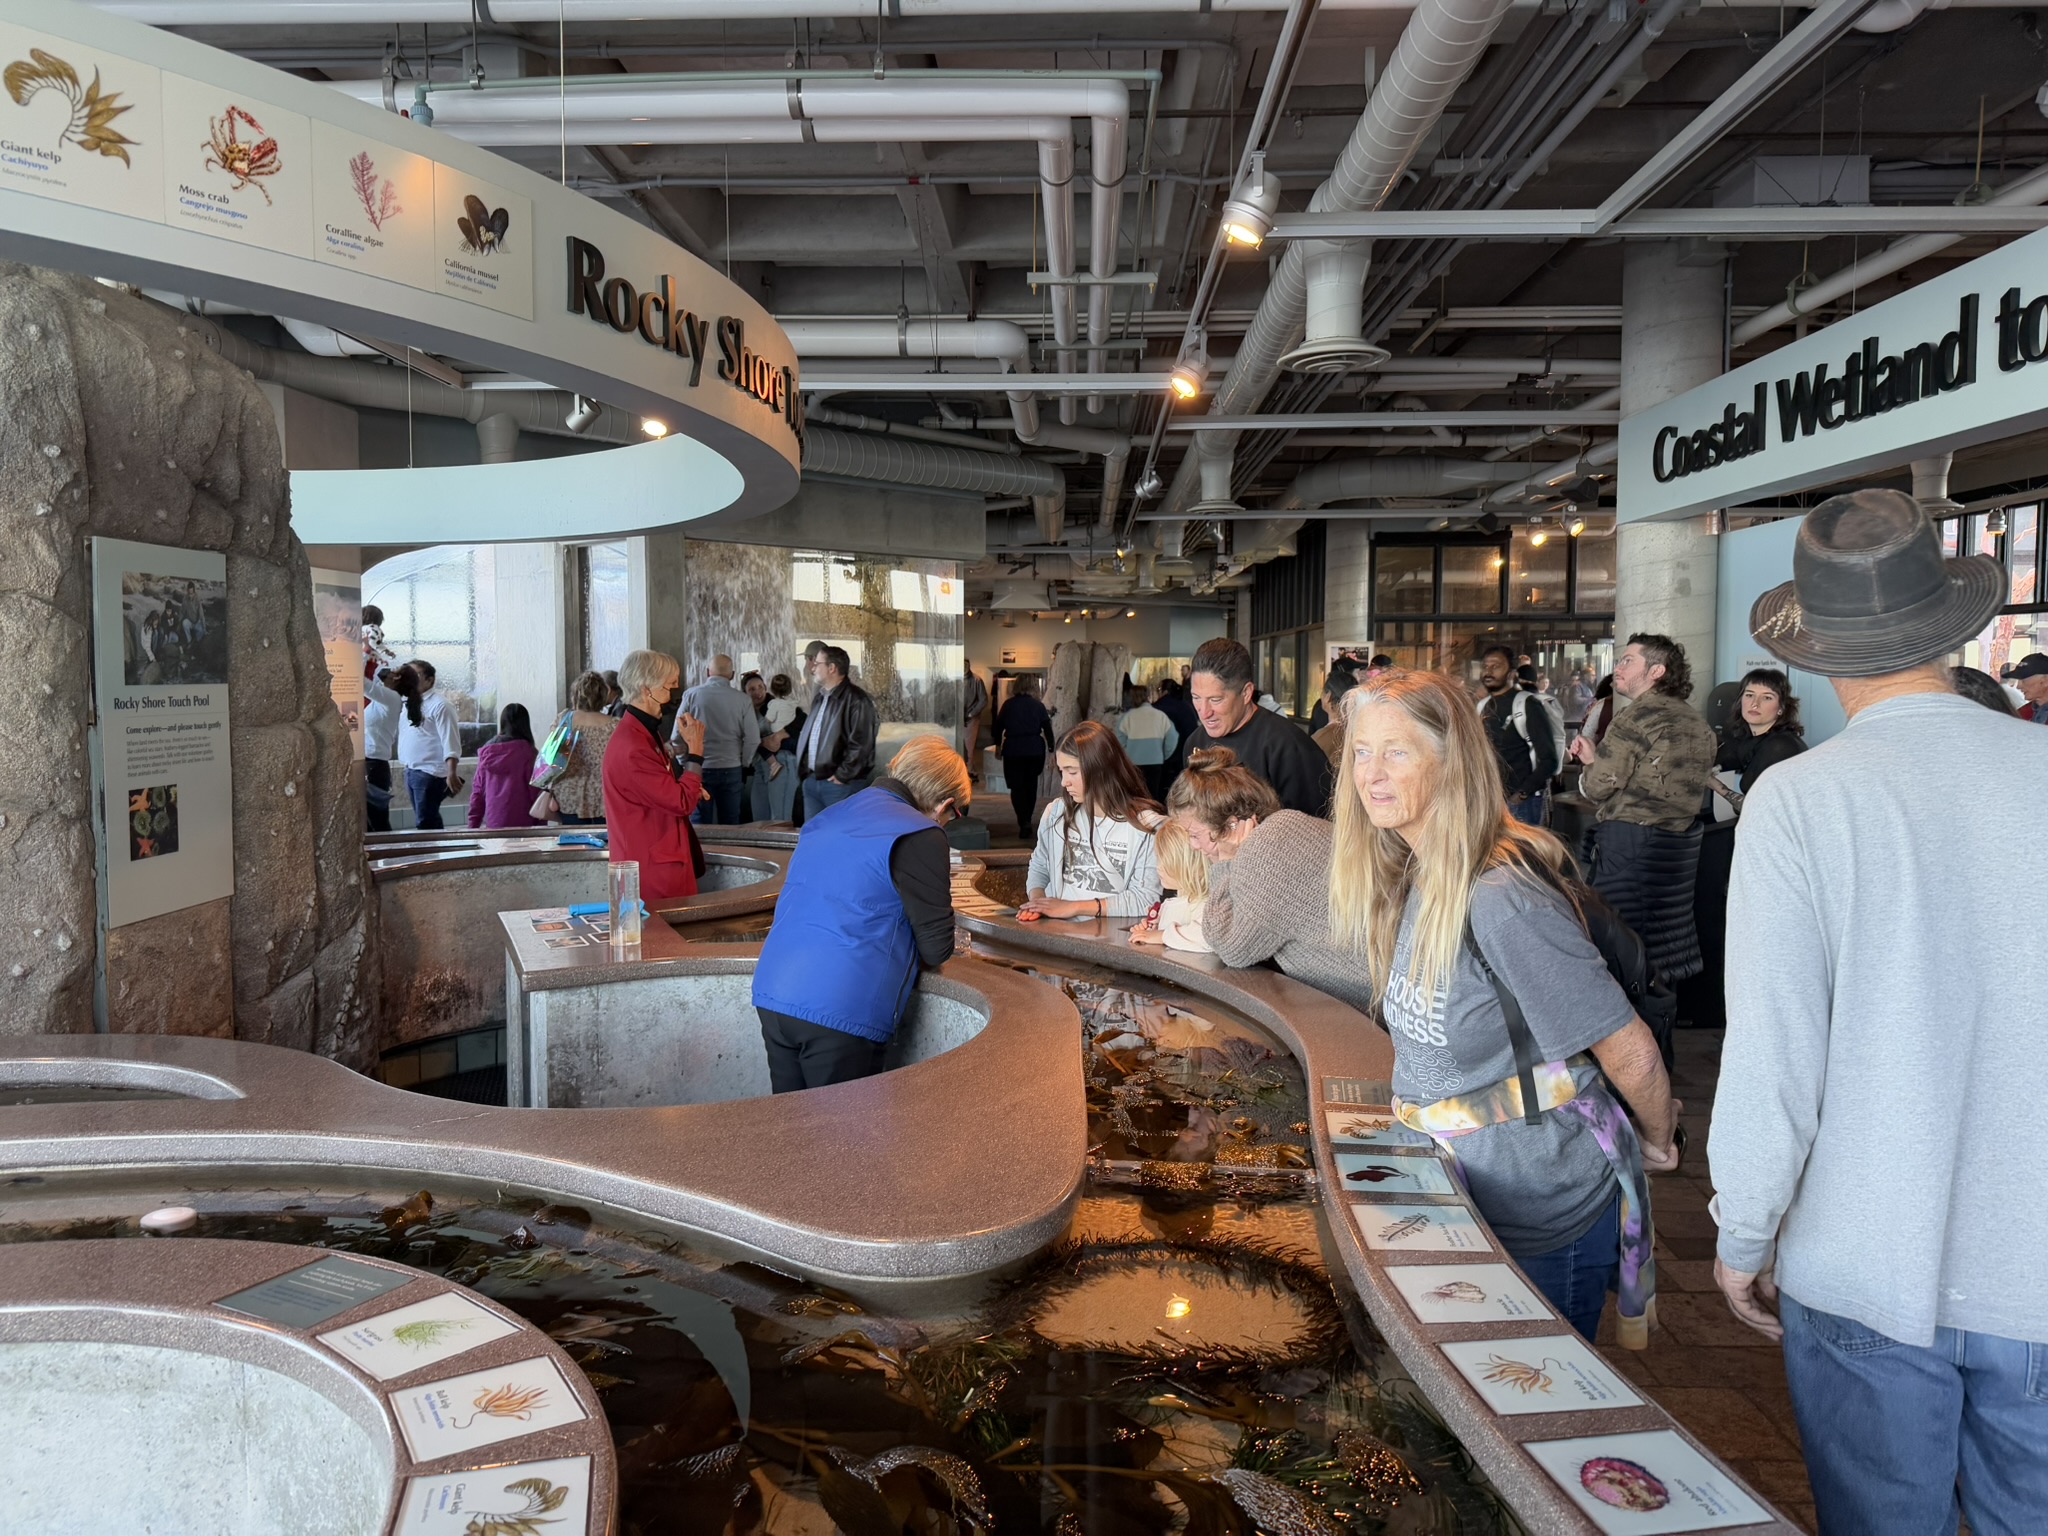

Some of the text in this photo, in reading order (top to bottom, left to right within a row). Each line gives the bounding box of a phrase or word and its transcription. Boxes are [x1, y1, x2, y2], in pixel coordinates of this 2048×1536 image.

[0, 140, 62, 164] Giant kelp
[179, 184, 230, 204] Moss crab
[180, 196, 248, 220] Cangrejo musgoso
[326, 224, 384, 248] Coralline algae
[326, 236, 340, 245] Alga
[444, 258, 499, 282] California mussel
[474, 278, 496, 290] California
[566, 236, 710, 387] Rocky
[717, 316, 785, 414] Shore
[1652, 287, 2048, 483] Coastal Wetland to
[114, 694, 210, 712] Rocky Shore Touch Pool
[126, 726, 142, 734] Come
[178, 723, 193, 733] please
[194, 721, 207, 730] touch
[208, 720, 222, 731] gently
[1385, 970, 1447, 1021] HOOSE
[1383, 996, 1448, 1047] NDNESS
[1574, 1380, 1587, 1390] kelp
[1582, 1390, 1597, 1400] Bull
[440, 1398, 452, 1409] kelp
[448, 1483, 466, 1515] Giant kelp
[1698, 1503, 1717, 1516] Red
